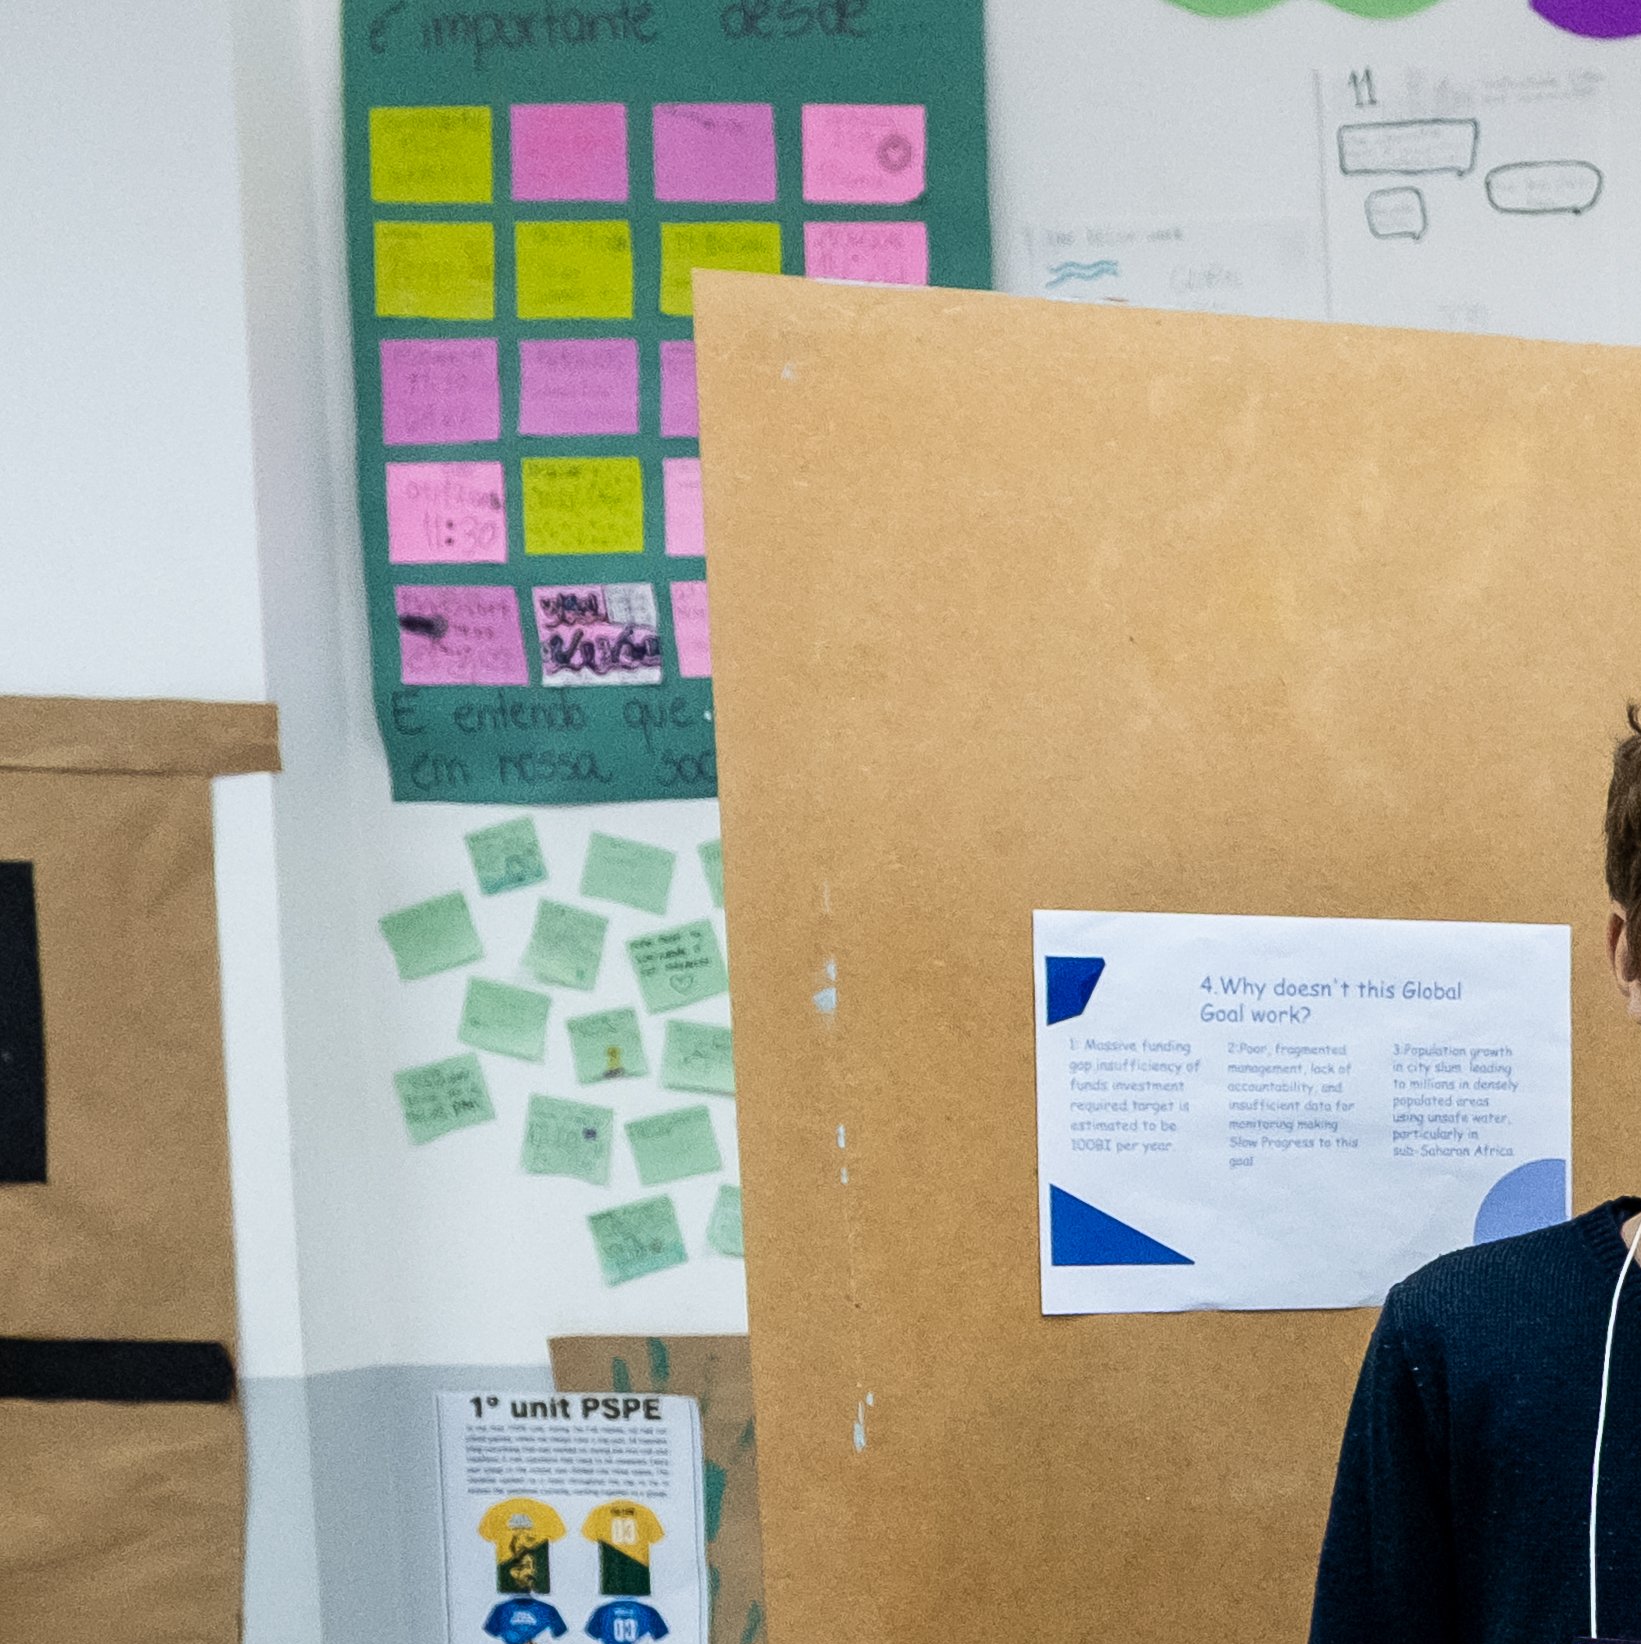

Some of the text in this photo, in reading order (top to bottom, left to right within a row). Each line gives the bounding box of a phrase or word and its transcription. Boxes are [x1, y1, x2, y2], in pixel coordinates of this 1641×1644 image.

[622, 697, 698, 754] que
[1200, 976, 1462, 1000] 4.Why doesn't this Global
[1200, 1003, 1312, 1024] Goal work?
[1085, 1039, 1191, 1056] Massive funding
[1275, 1043, 1346, 1058] fragmented
[1470, 1045, 1513, 1059] growth
[1069, 1058, 1200, 1075] gap insufficiency of
[1311, 1063, 1351, 1075] lack of
[1407, 1061, 1511, 1076] city leading
[1070, 1078, 1184, 1092] funds investment
[1321, 1082, 1342, 1093] and
[1393, 1078, 1519, 1092] to millions densely
[1070, 1100, 1174, 1115] required target
[1229, 1099, 1355, 1111] insufficient data for
[1393, 1094, 1489, 1108] populated areas
[1393, 1111, 1469, 1126] using unsafe
[1070, 1120, 1176, 1132] estimated to be
[1229, 1120, 1338, 1133] monitoring making
[1393, 1128, 1463, 1142] particularly
[1116, 1141, 1173, 1154] per year
[1229, 1136, 1359, 1153] Slow Progress to this
[1420, 1144, 1513, 1157] Saharan Africa
[511, 1397, 570, 1419] unit
[581, 1397, 662, 1420] PSPE
